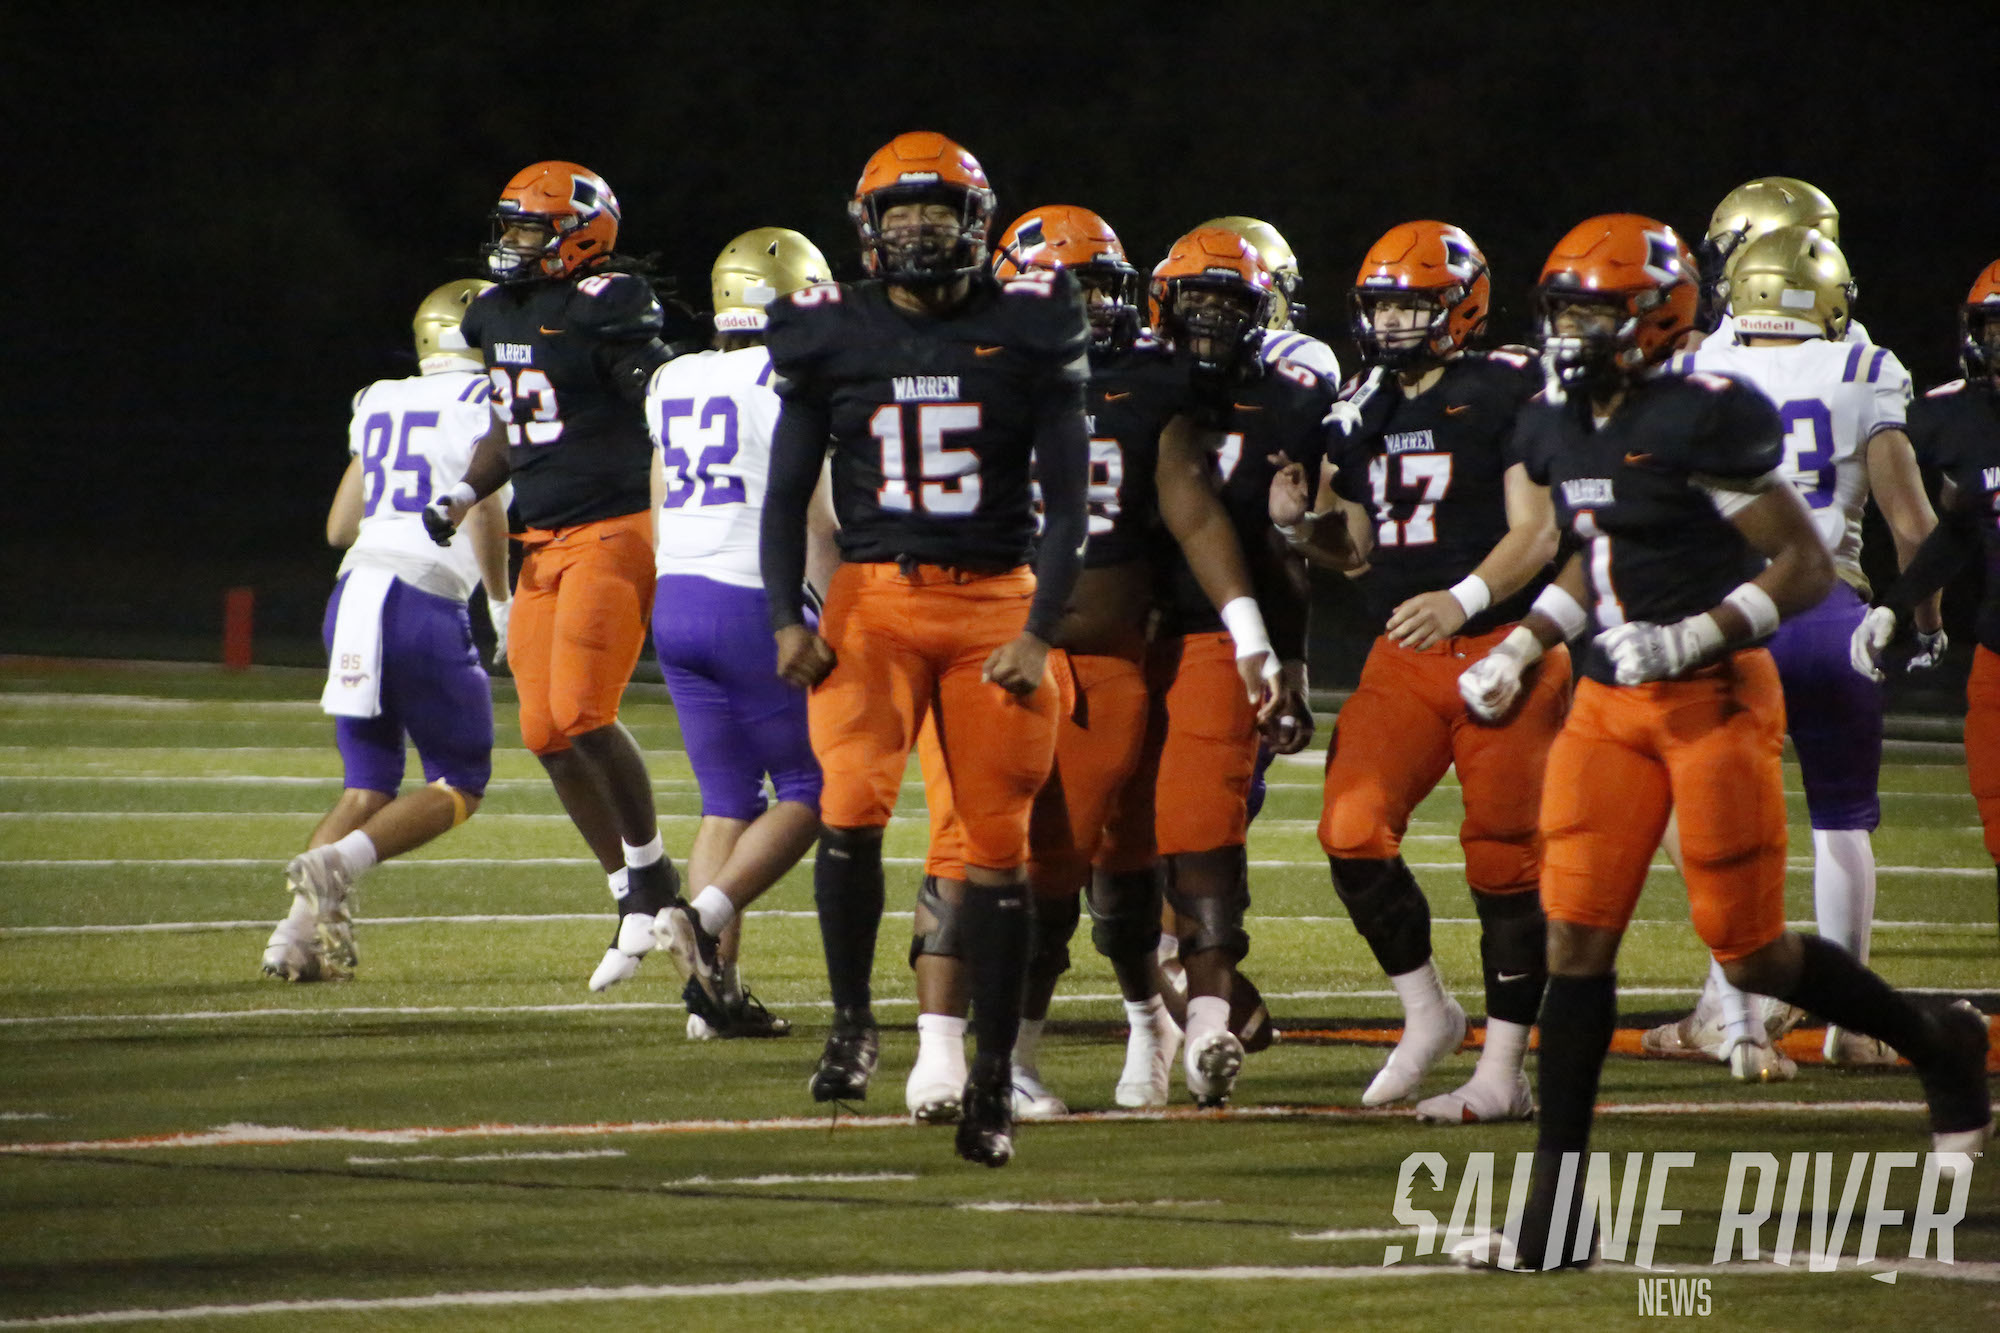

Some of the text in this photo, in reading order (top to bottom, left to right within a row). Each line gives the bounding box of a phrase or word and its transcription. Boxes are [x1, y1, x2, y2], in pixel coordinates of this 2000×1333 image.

[494, 342, 533, 365] WARREN
[1740, 318, 1795, 331] Riddell
[892, 376, 960, 401] WARREN
[363, 410, 440, 518] 85
[661, 395, 747, 508] 52
[869, 402, 982, 516] 15
[1384, 430, 1435, 454] WARREN
[1367, 452, 1454, 546] 17
